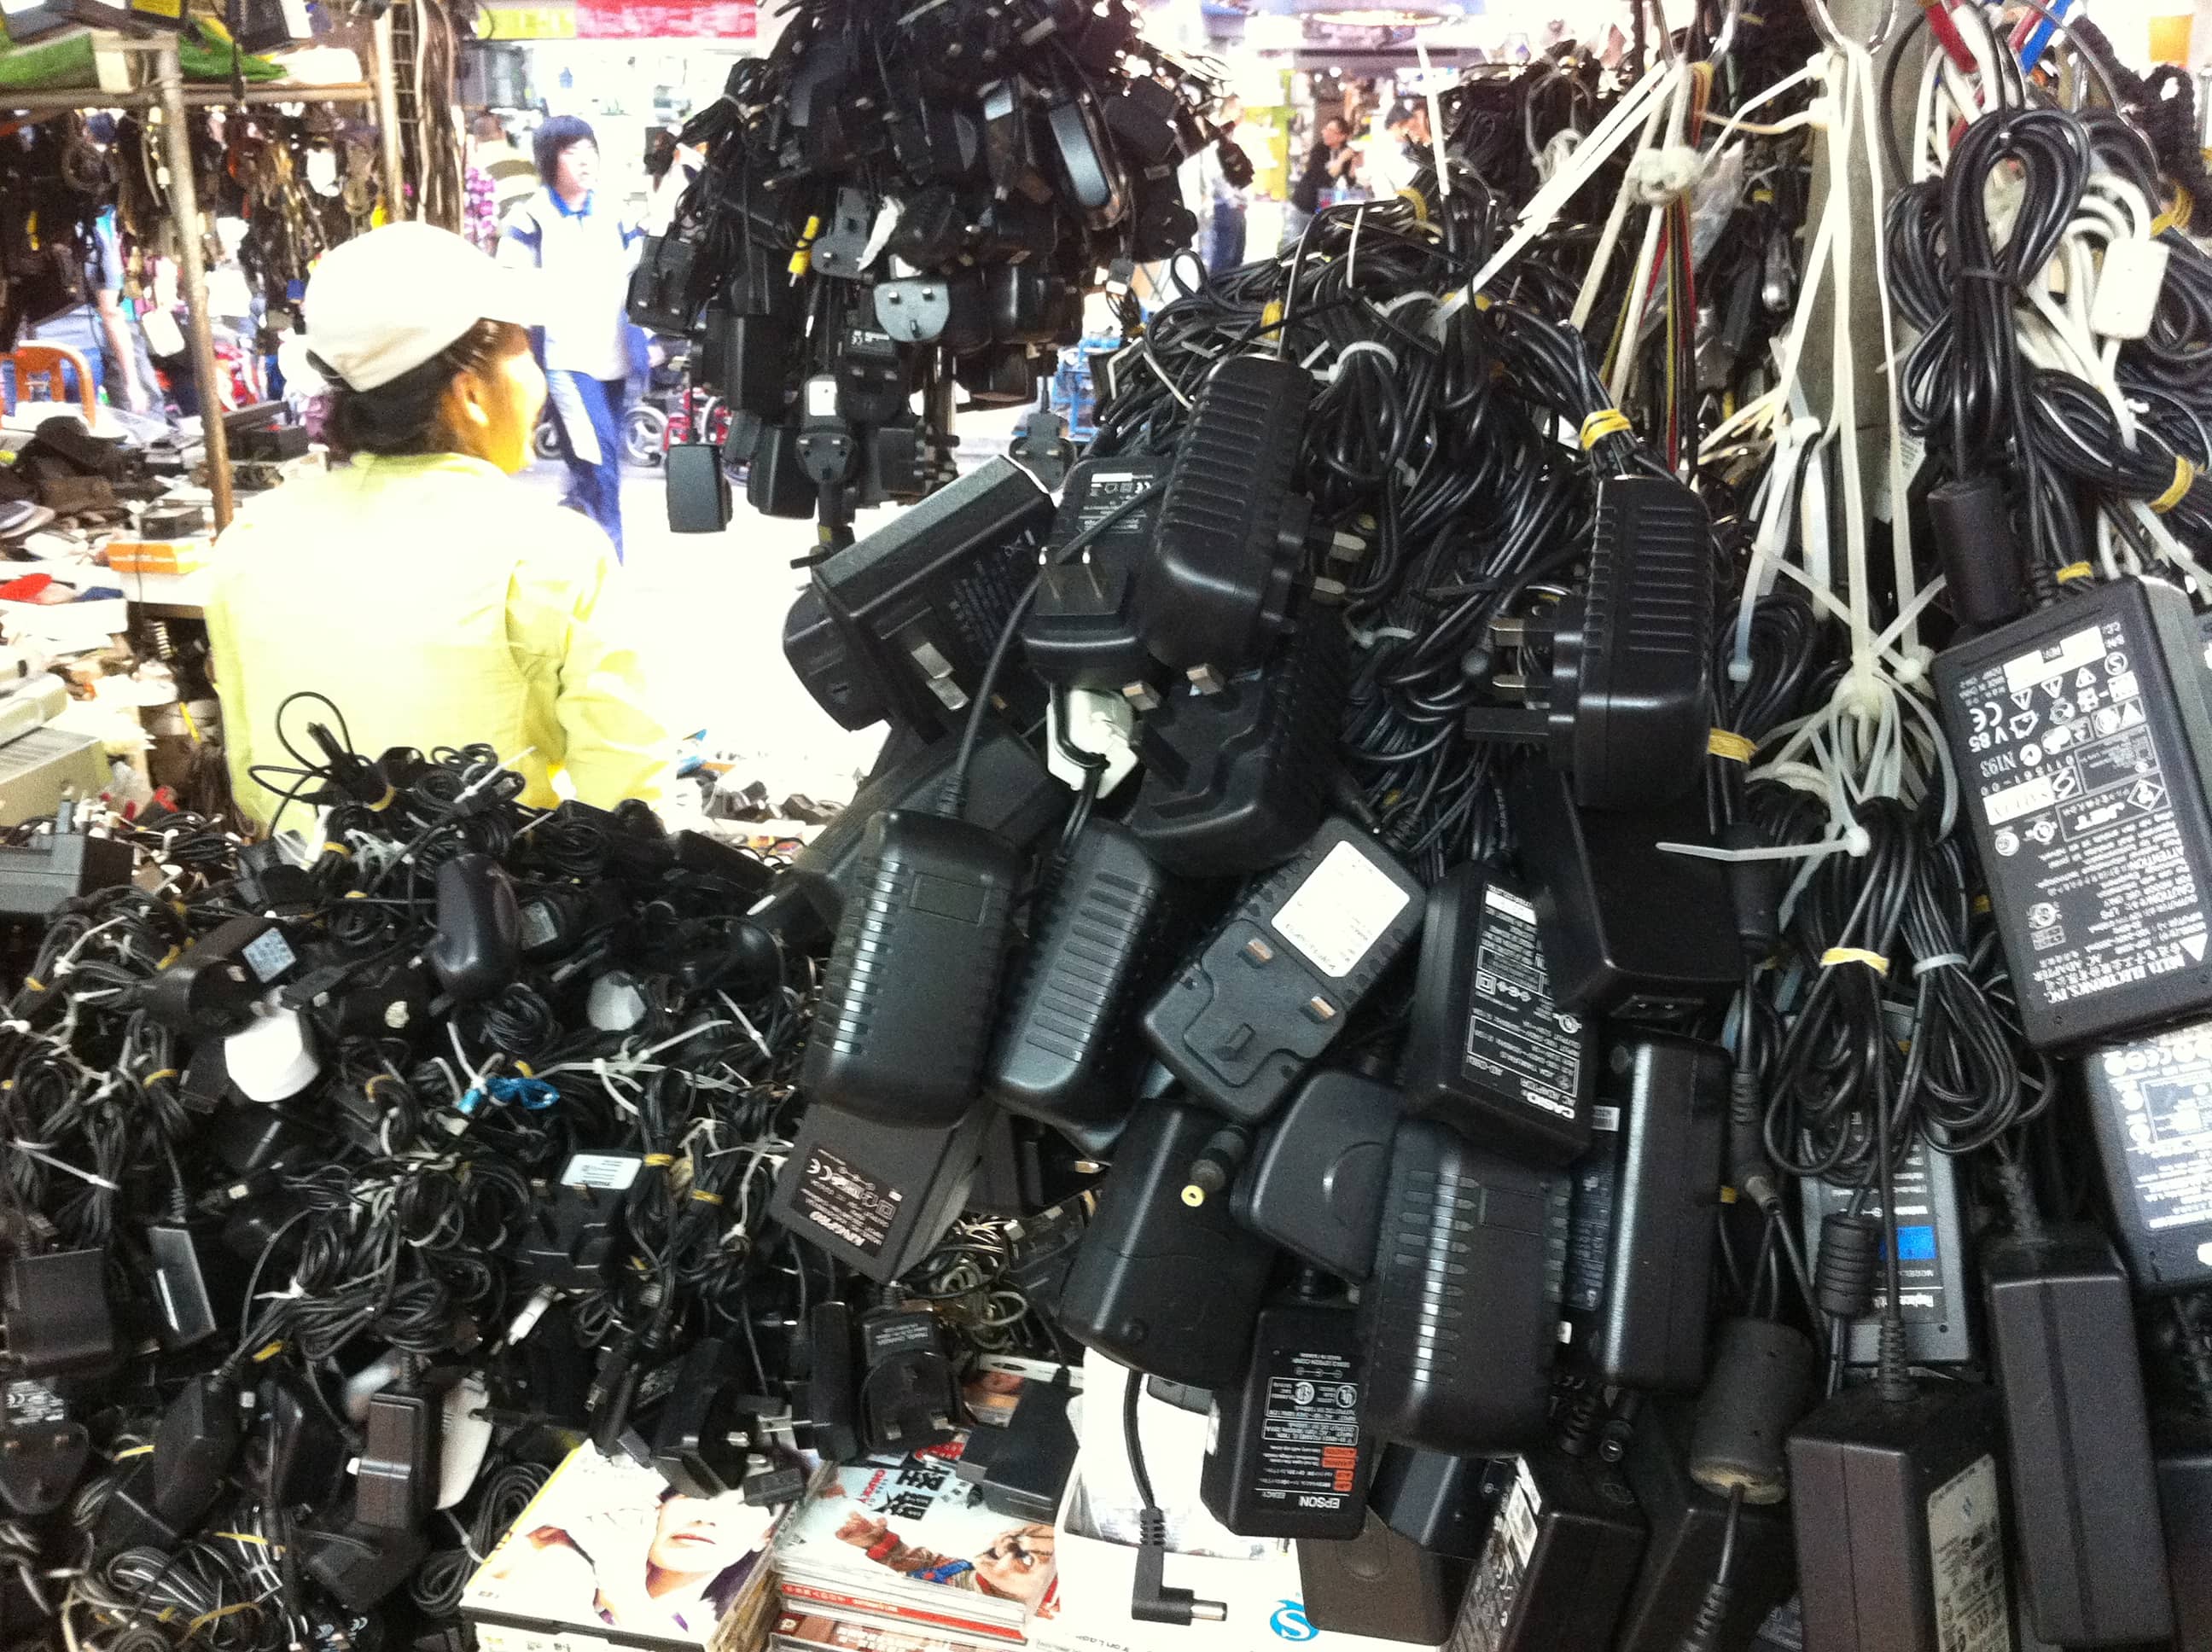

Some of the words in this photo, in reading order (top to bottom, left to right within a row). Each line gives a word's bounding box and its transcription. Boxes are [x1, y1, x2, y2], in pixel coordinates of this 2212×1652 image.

[1970, 701, 2002, 731] CE
[1526, 1091, 1574, 1118] CASIO
[806, 1158, 833, 1180] CE
[1299, 1495, 1340, 1509] EPSON
